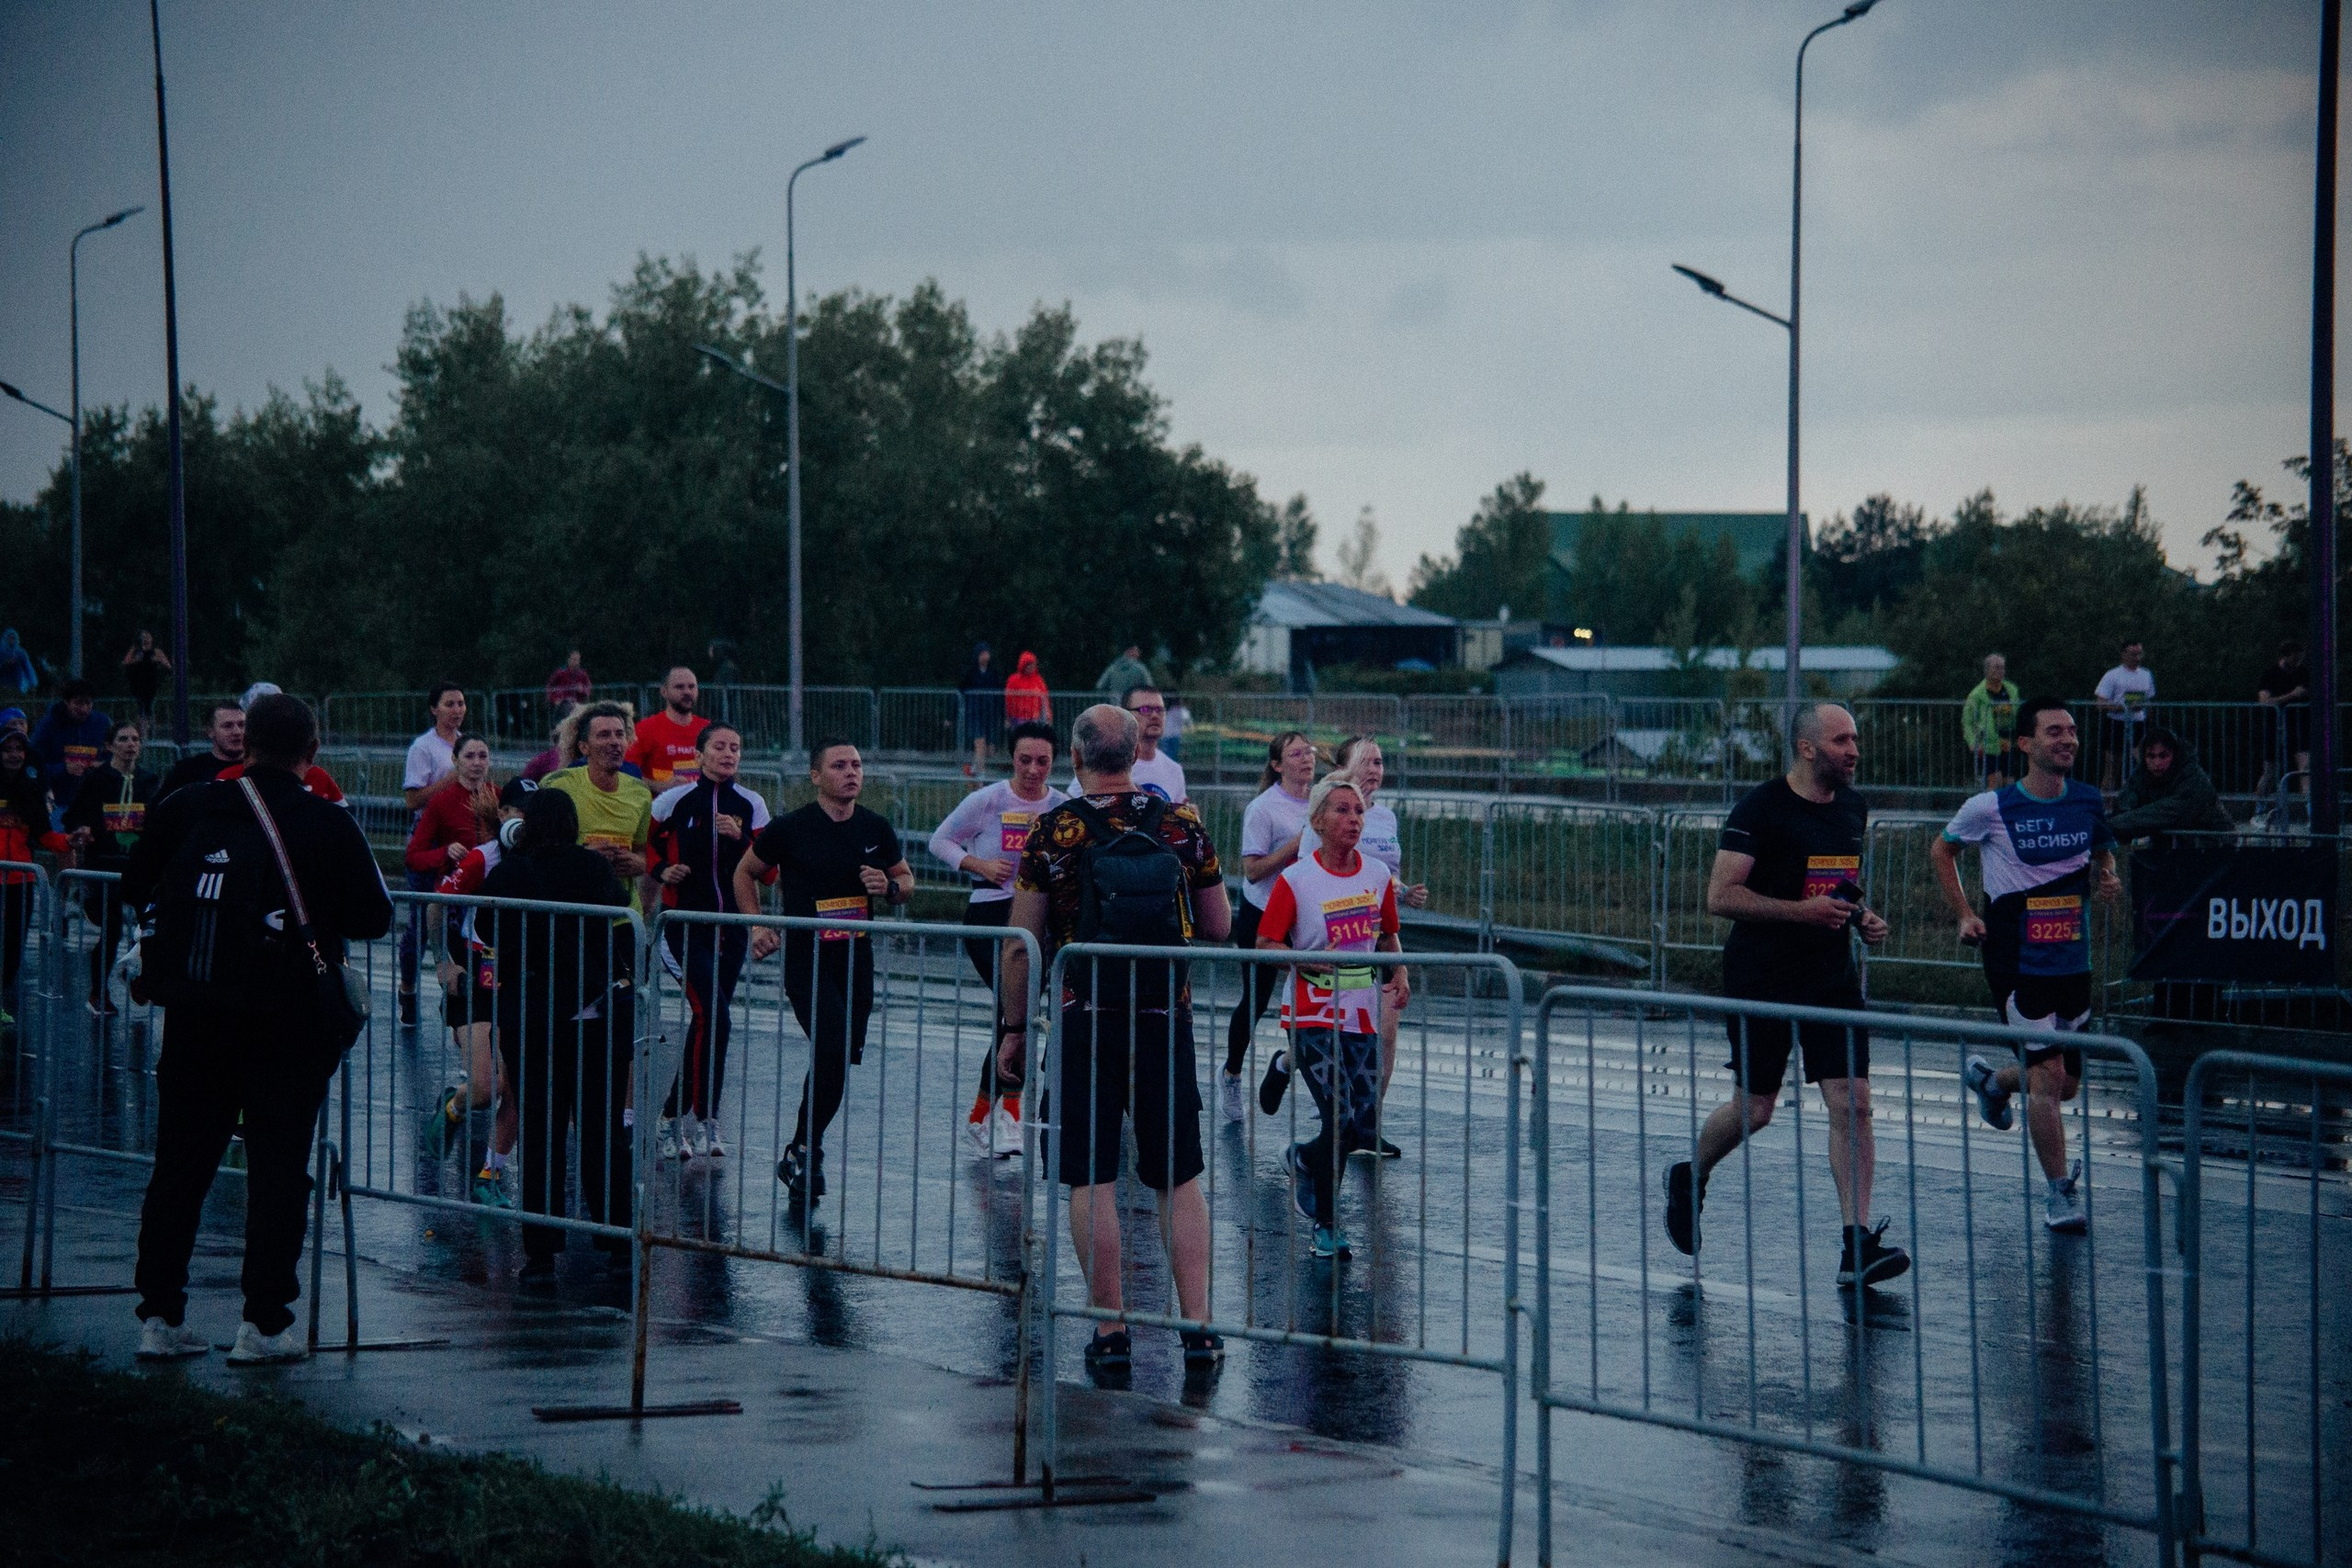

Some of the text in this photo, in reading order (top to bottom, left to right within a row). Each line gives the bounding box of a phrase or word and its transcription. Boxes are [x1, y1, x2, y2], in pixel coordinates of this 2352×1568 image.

[2015, 818, 2055, 832] БЕГУ
[2038, 831, 2088, 848] СИБУР
[1330, 919, 1371, 941] 3114
[2031, 921, 2072, 939] 3225
[2208, 897, 2325, 950] ВЫХОД
